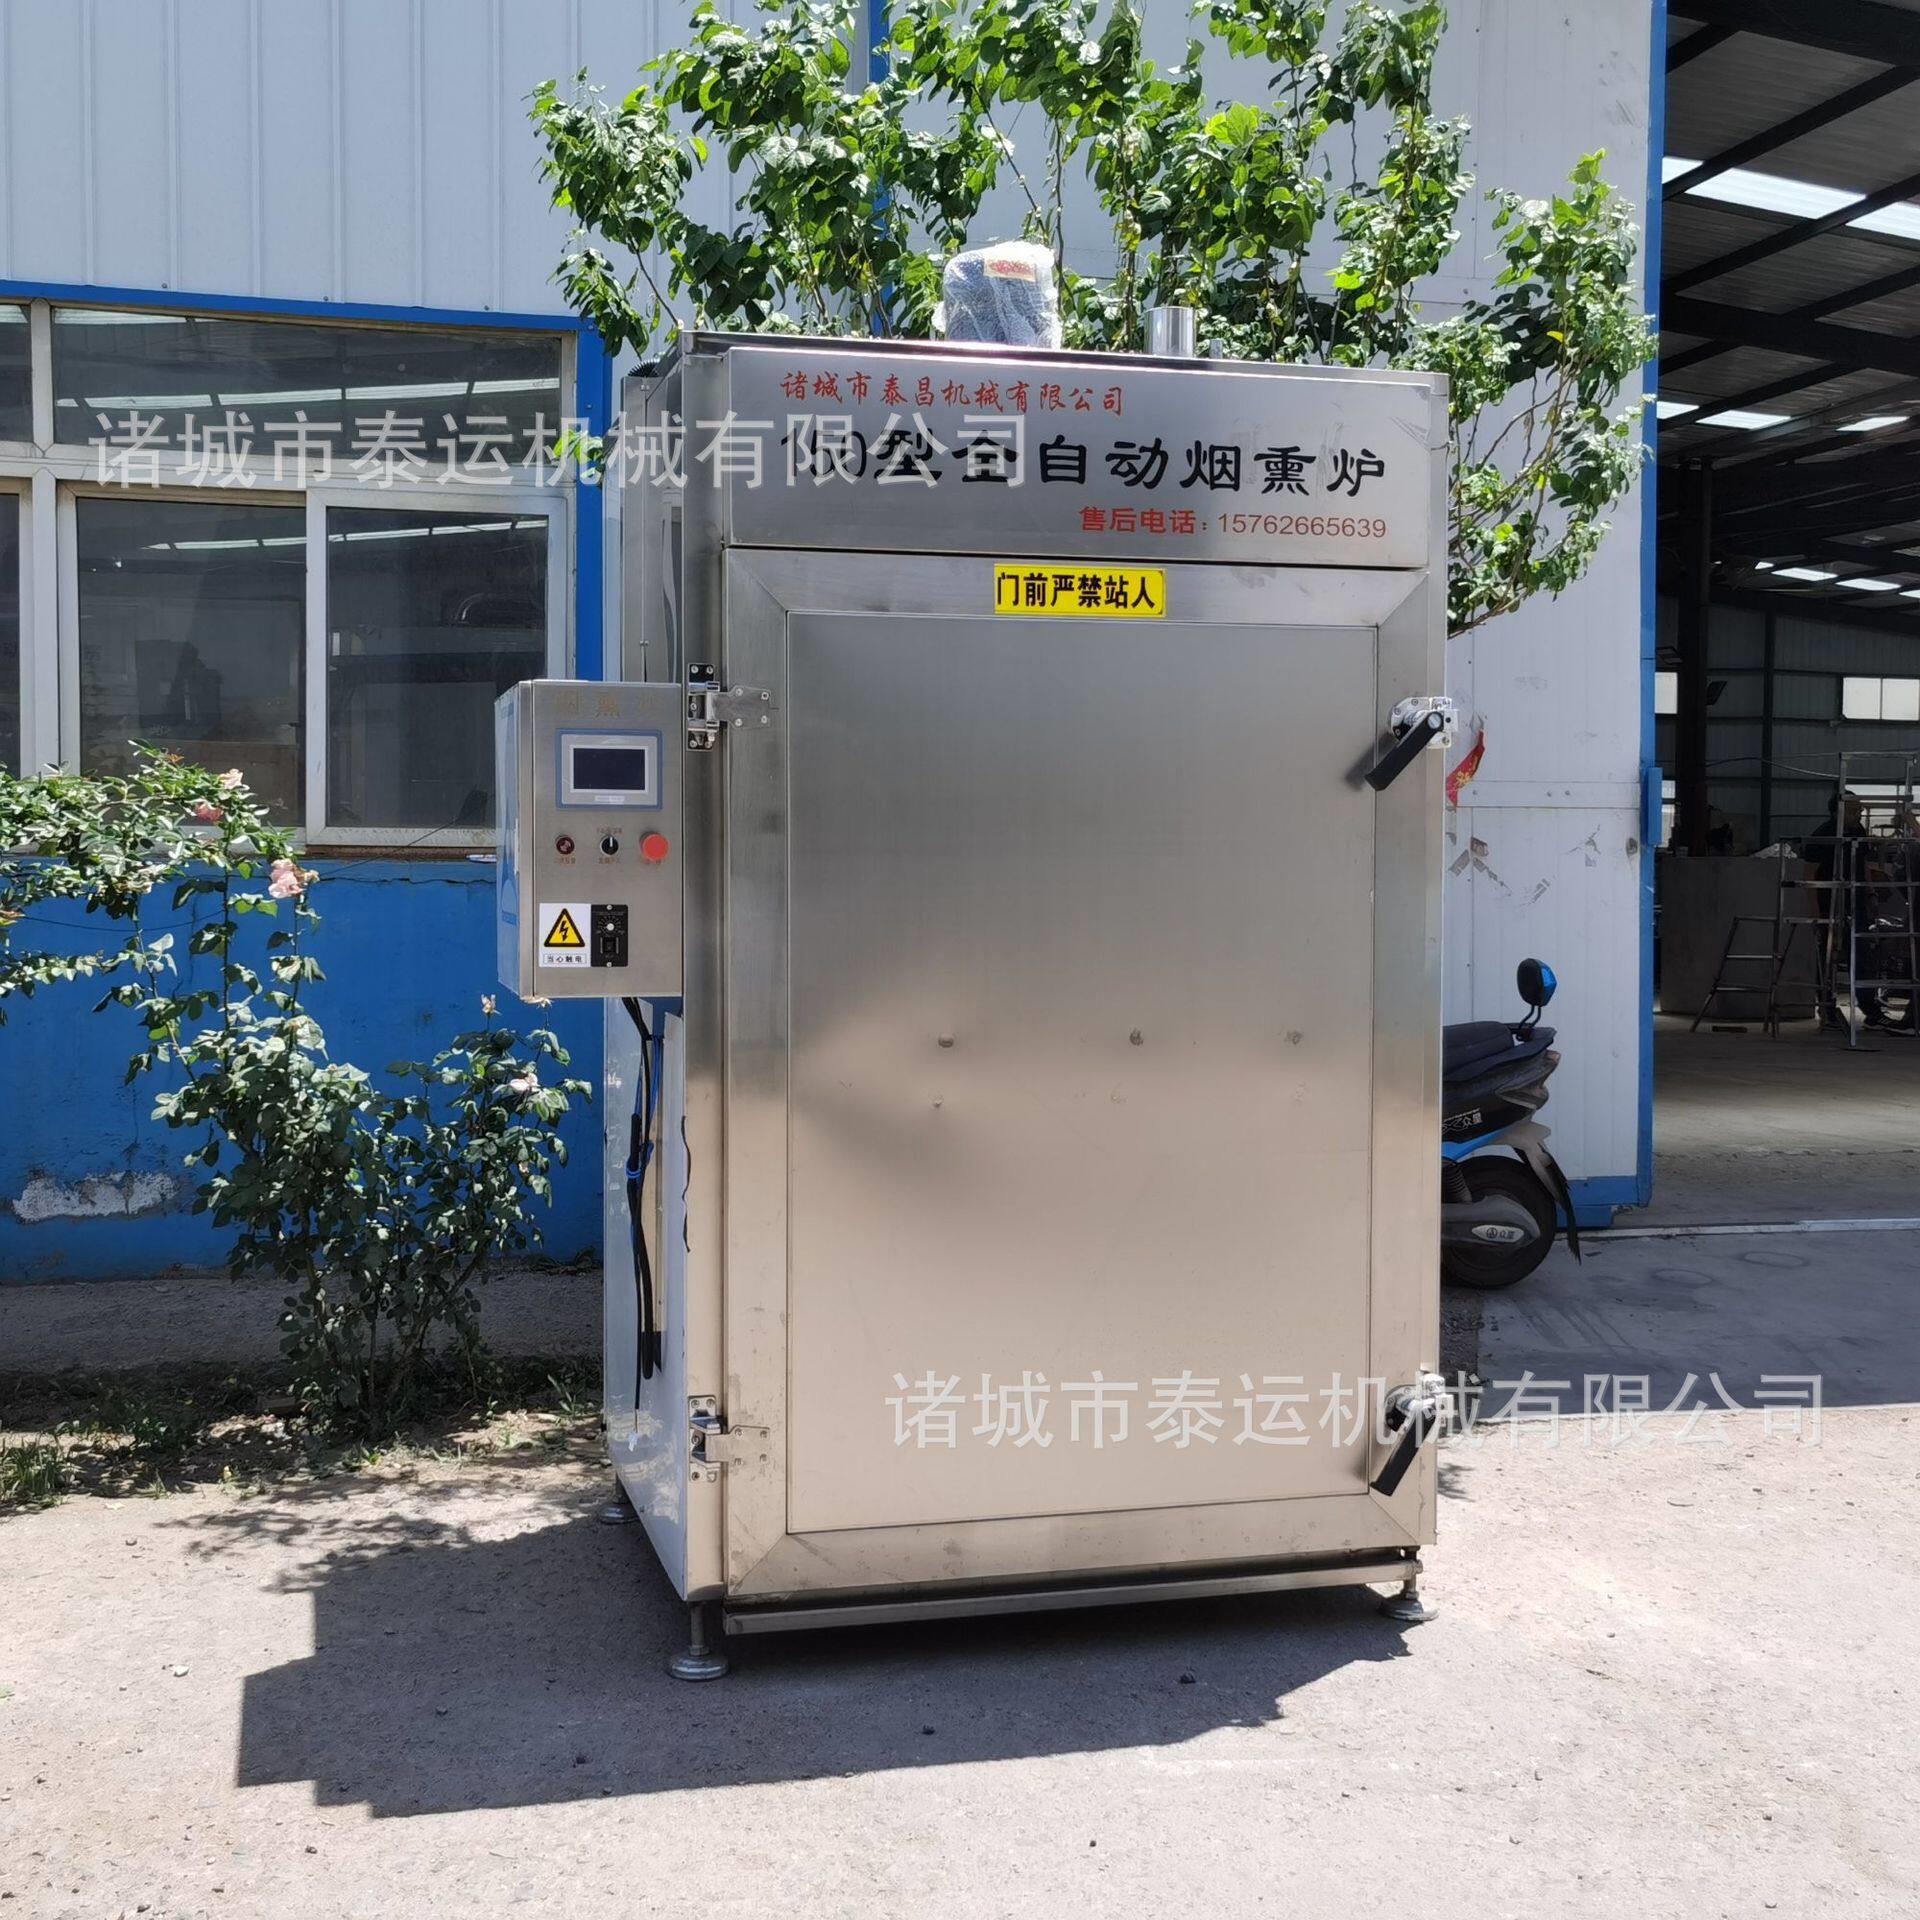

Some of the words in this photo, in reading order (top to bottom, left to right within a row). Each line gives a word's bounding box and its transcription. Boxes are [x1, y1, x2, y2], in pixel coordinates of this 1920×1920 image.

[780, 371, 1123, 416] 诸城市泰昌机械有限公司
[997, 570, 1156, 609] 门前严禁站人
[547, 955, 583, 963] 当心触电
